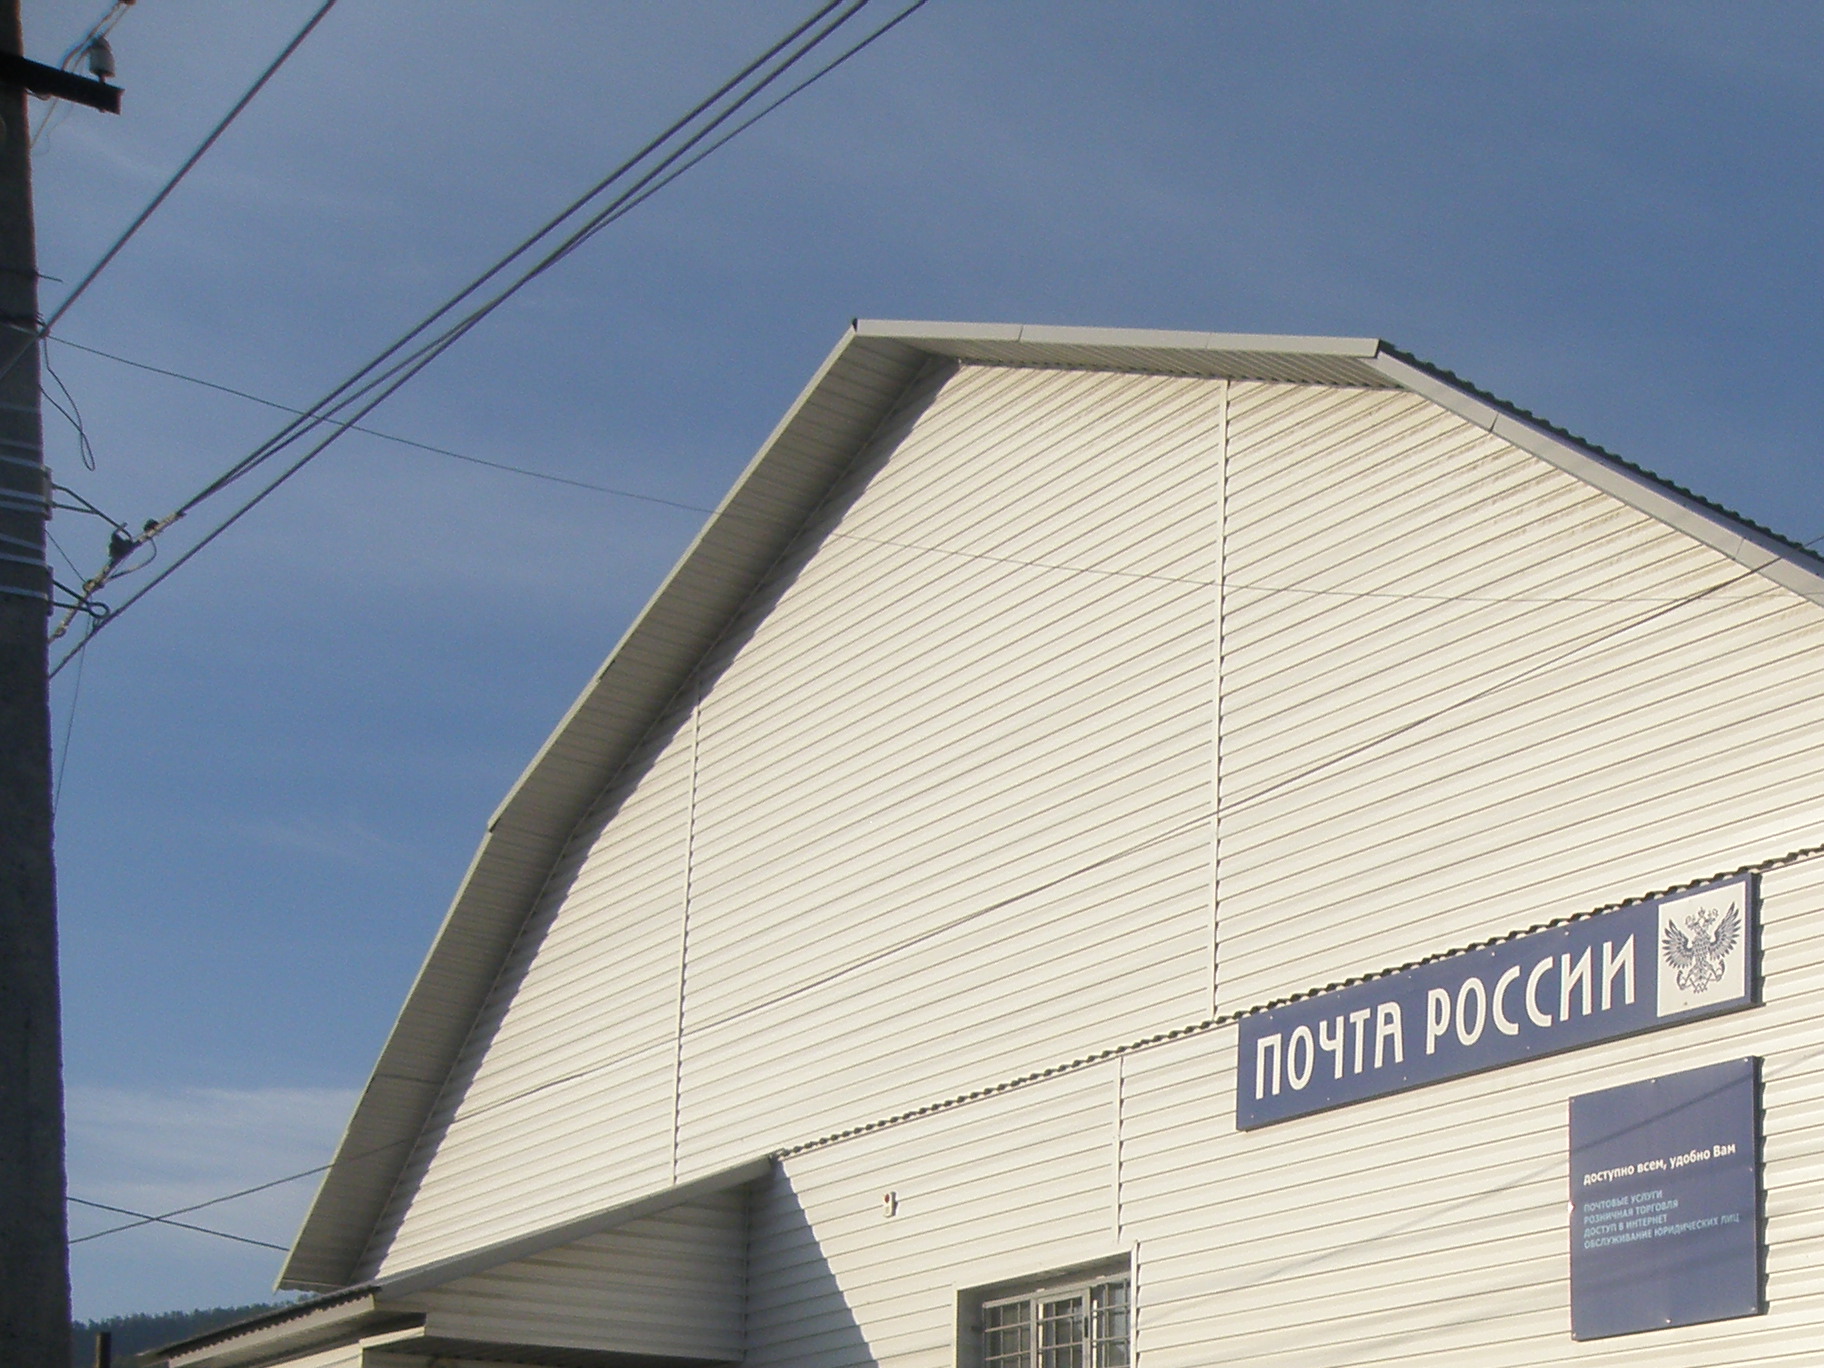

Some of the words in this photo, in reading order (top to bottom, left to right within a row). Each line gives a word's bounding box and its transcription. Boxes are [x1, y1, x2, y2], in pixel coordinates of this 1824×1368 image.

[1255, 1001, 1404, 1100] ПОЧТА
[1426, 933, 1636, 1056] РОССИИ
[1583, 1165, 1635, 1186] доступно
[1637, 1158, 1668, 1173] всем,
[1669, 1149, 1711, 1169] удобно
[1713, 1143, 1736, 1158] Вам
[1583, 1195, 1629, 1213] ПОЧТОВЫЕ
[1631, 1189, 1663, 1204] УСЛУГИ
[1583, 1207, 1634, 1225] РОЗНИЧНАЯ
[1636, 1199, 1679, 1215] ТОРГОВЛЯ
[1583, 1221, 1617, 1238] ДОСТУП
[1626, 1213, 1668, 1230] ИНТЕРНЕТ
[1583, 1231, 1652, 1249] ОБСЛУЖИВАНИЕ
[1654, 1217, 1719, 1238] ЮРИДИЧЕСКИХ
